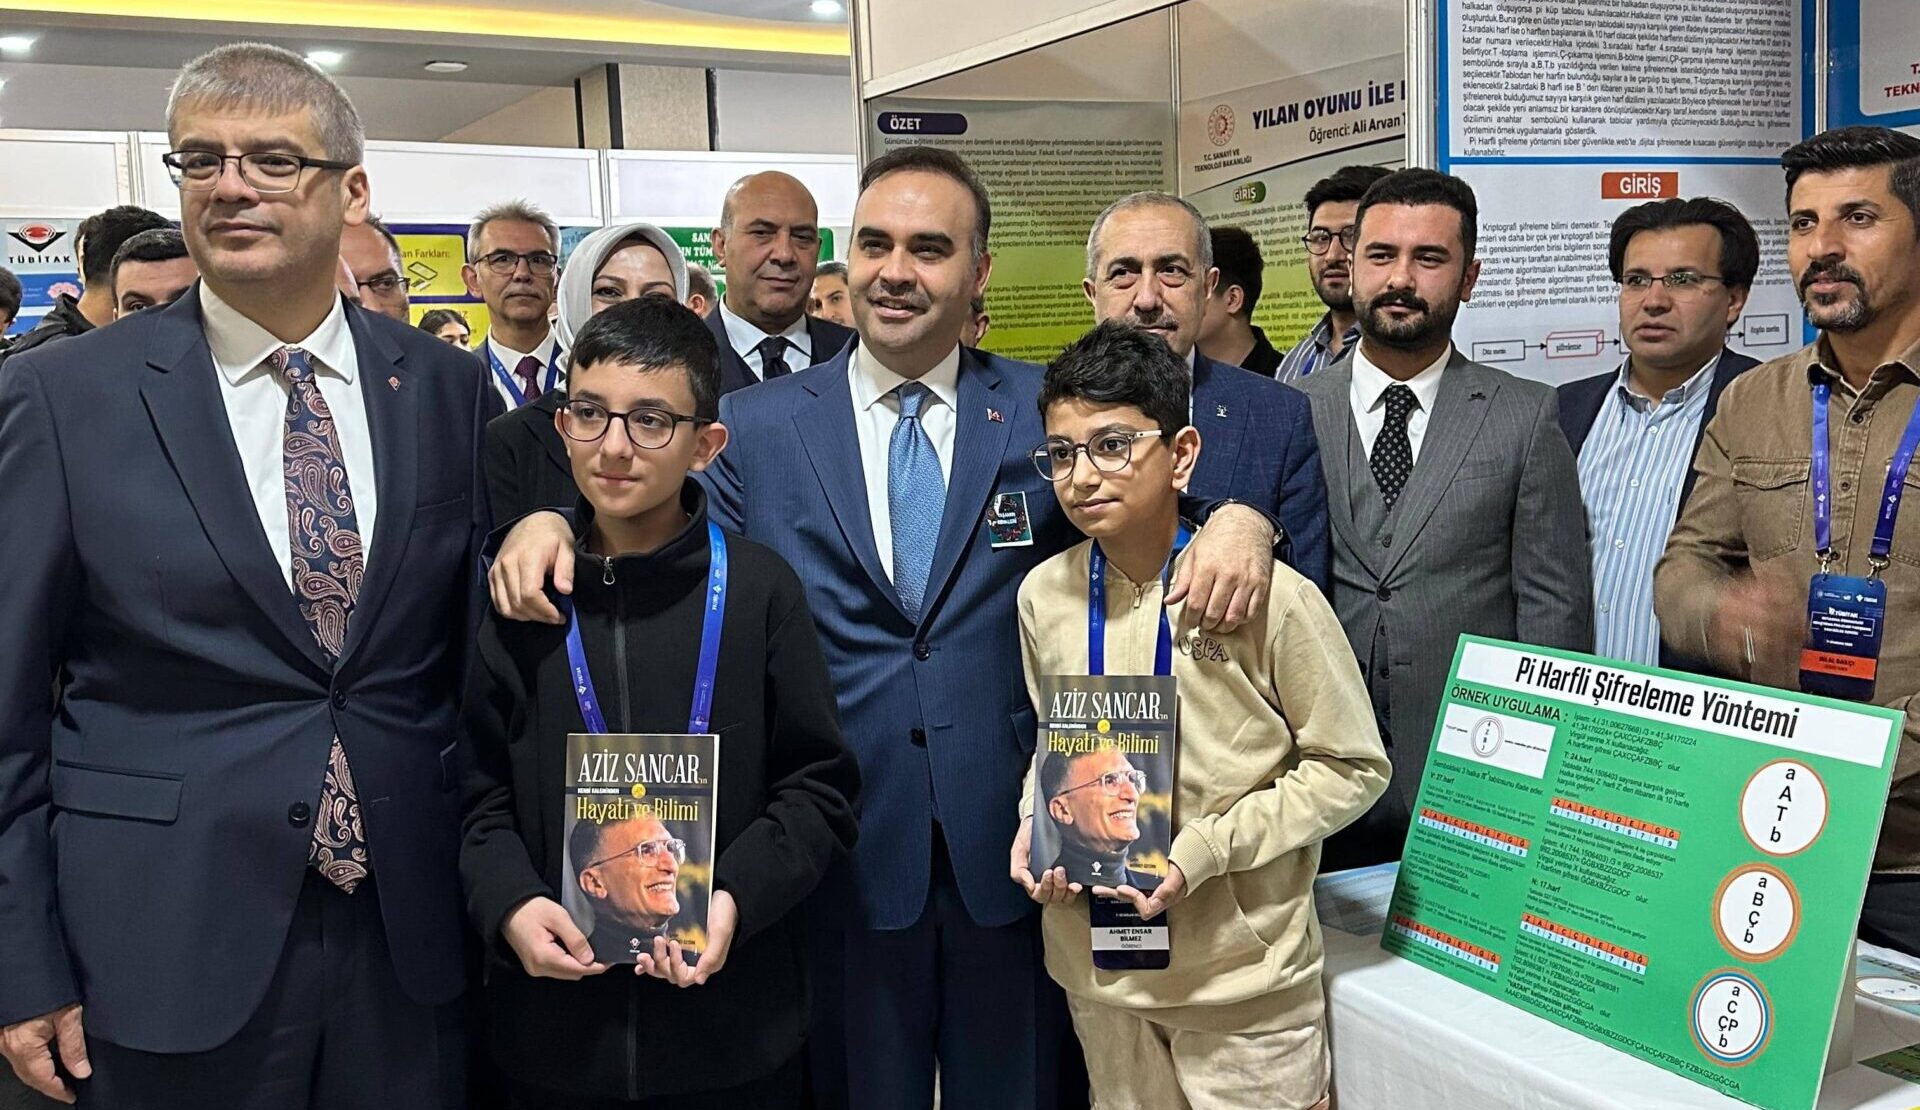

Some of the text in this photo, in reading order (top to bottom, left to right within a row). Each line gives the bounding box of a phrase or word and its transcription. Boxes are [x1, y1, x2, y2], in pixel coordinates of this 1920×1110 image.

[1252, 103, 1299, 130] YILAN
[1303, 89, 1362, 120] OYUNU
[1368, 80, 1395, 108] İLE
[890, 114, 921, 130] ÖZET
[1309, 117, 1401, 144] Öğrenci: Ali Arvan
[1619, 173, 1662, 198] GİRİŞ
[1234, 186, 1256, 202] GİRİŞ
[692, 232, 712, 243] SAN
[9, 255, 71, 264] TÜBİTAK
[1049, 687, 1087, 719] AZİZ
[1091, 692, 1160, 720] SANCAR
[1451, 684, 1491, 706] ÖRNEK
[1493, 695, 1560, 721] UYGULAMA
[1515, 656, 1800, 739] Pi Harfli Şifreleme Yöntemi
[1047, 731, 1159, 757] Hayatı ve Bilimi
[577, 748, 620, 783] AZİZ
[624, 753, 700, 784] SANCAR
[1786, 769, 1795, 780] a
[1779, 786, 1791, 802] A
[576, 797, 699, 825] Hayatı ve Bilimi
[1777, 805, 1788, 821] T
[1770, 826, 1781, 842] b
[1759, 878, 1767, 888] a
[1753, 892, 1764, 906] B
[1748, 911, 1760, 927] Ç
[1744, 929, 1753, 943] b
[1732, 985, 1740, 996] a
[1728, 1001, 1737, 1013] C
[1719, 1016, 1738, 1031] ÇP
[1718, 1034, 1727, 1049] b
